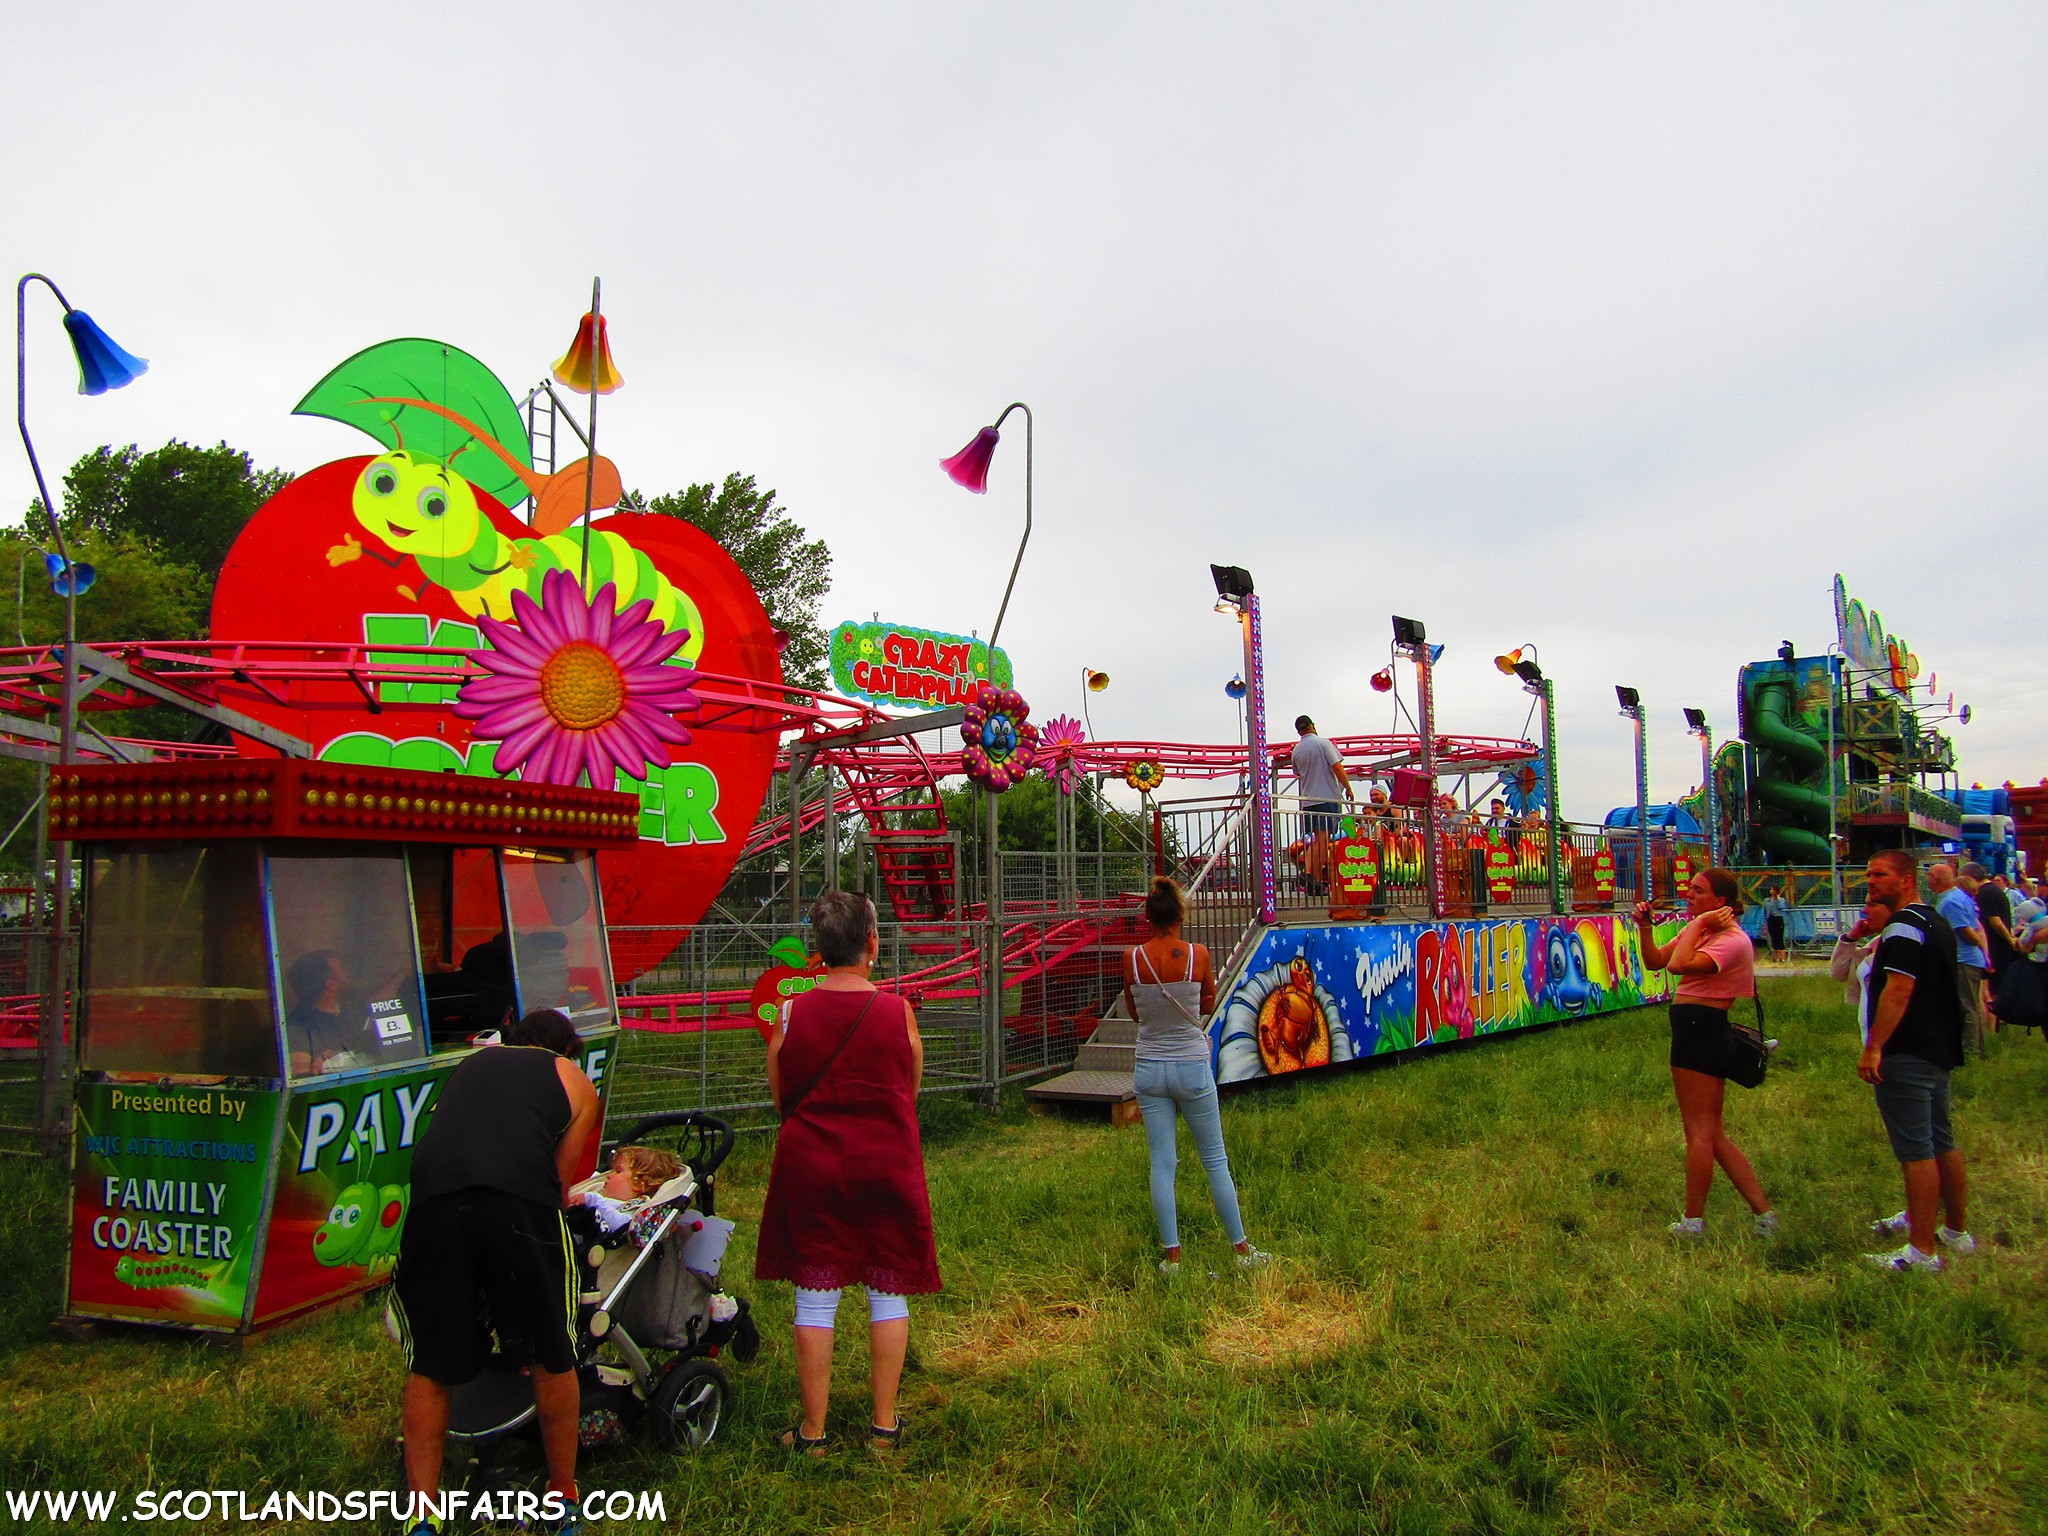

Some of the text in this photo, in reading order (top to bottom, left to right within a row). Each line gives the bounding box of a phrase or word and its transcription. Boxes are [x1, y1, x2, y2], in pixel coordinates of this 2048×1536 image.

[883, 632, 972, 677] CRAZY
[777, 975, 828, 996] CRA
[1356, 929, 1411, 1014] Family
[371, 998, 403, 1013] PRICE
[111, 1089, 247, 1122] Presented by
[298, 1078, 437, 1174] PAY
[127, 1137, 257, 1163] ATTRACTIONS
[104, 1176, 228, 1216] FAMILY
[92, 1216, 233, 1261] COASTER
